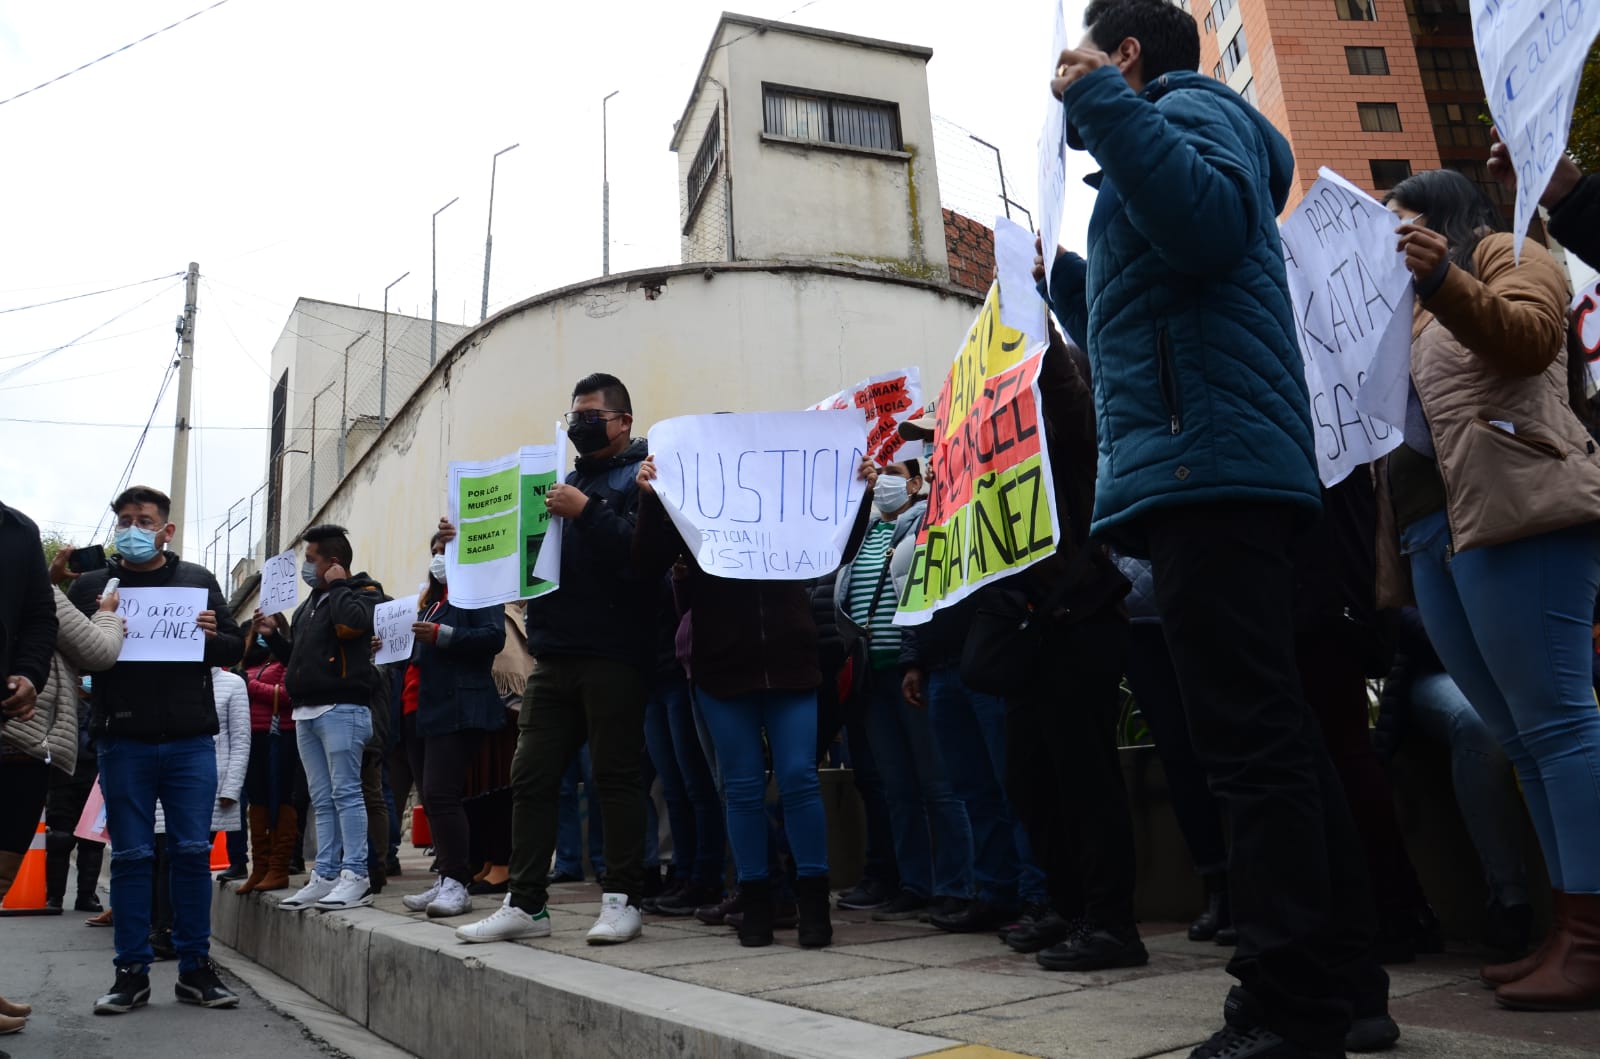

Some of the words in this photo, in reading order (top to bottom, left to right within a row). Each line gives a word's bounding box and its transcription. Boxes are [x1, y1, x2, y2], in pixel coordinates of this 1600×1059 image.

[1304, 184, 1370, 248] PARA
[1292, 251, 1394, 361] KATA
[952, 302, 1025, 424] AÑO
[859, 382, 900, 405] CLAMAN
[865, 399, 904, 419] USTICIA
[468, 489, 485, 498] POR
[486, 485, 499, 495] LOS
[533, 484, 546, 497] NI
[923, 456, 944, 530] DE
[467, 496, 502, 510] MUERTOS
[503, 492, 513, 502] DE
[967, 465, 1053, 580] AÑEZ
[467, 530, 500, 542] SENKATA
[501, 528, 507, 536] Y
[466, 543, 495, 554] SACABA
[147, 602, 194, 618] años
[123, 630, 145, 640] ra
[377, 626, 388, 641] NO
[388, 622, 400, 638] SE
[389, 633, 411, 655] ROBA
